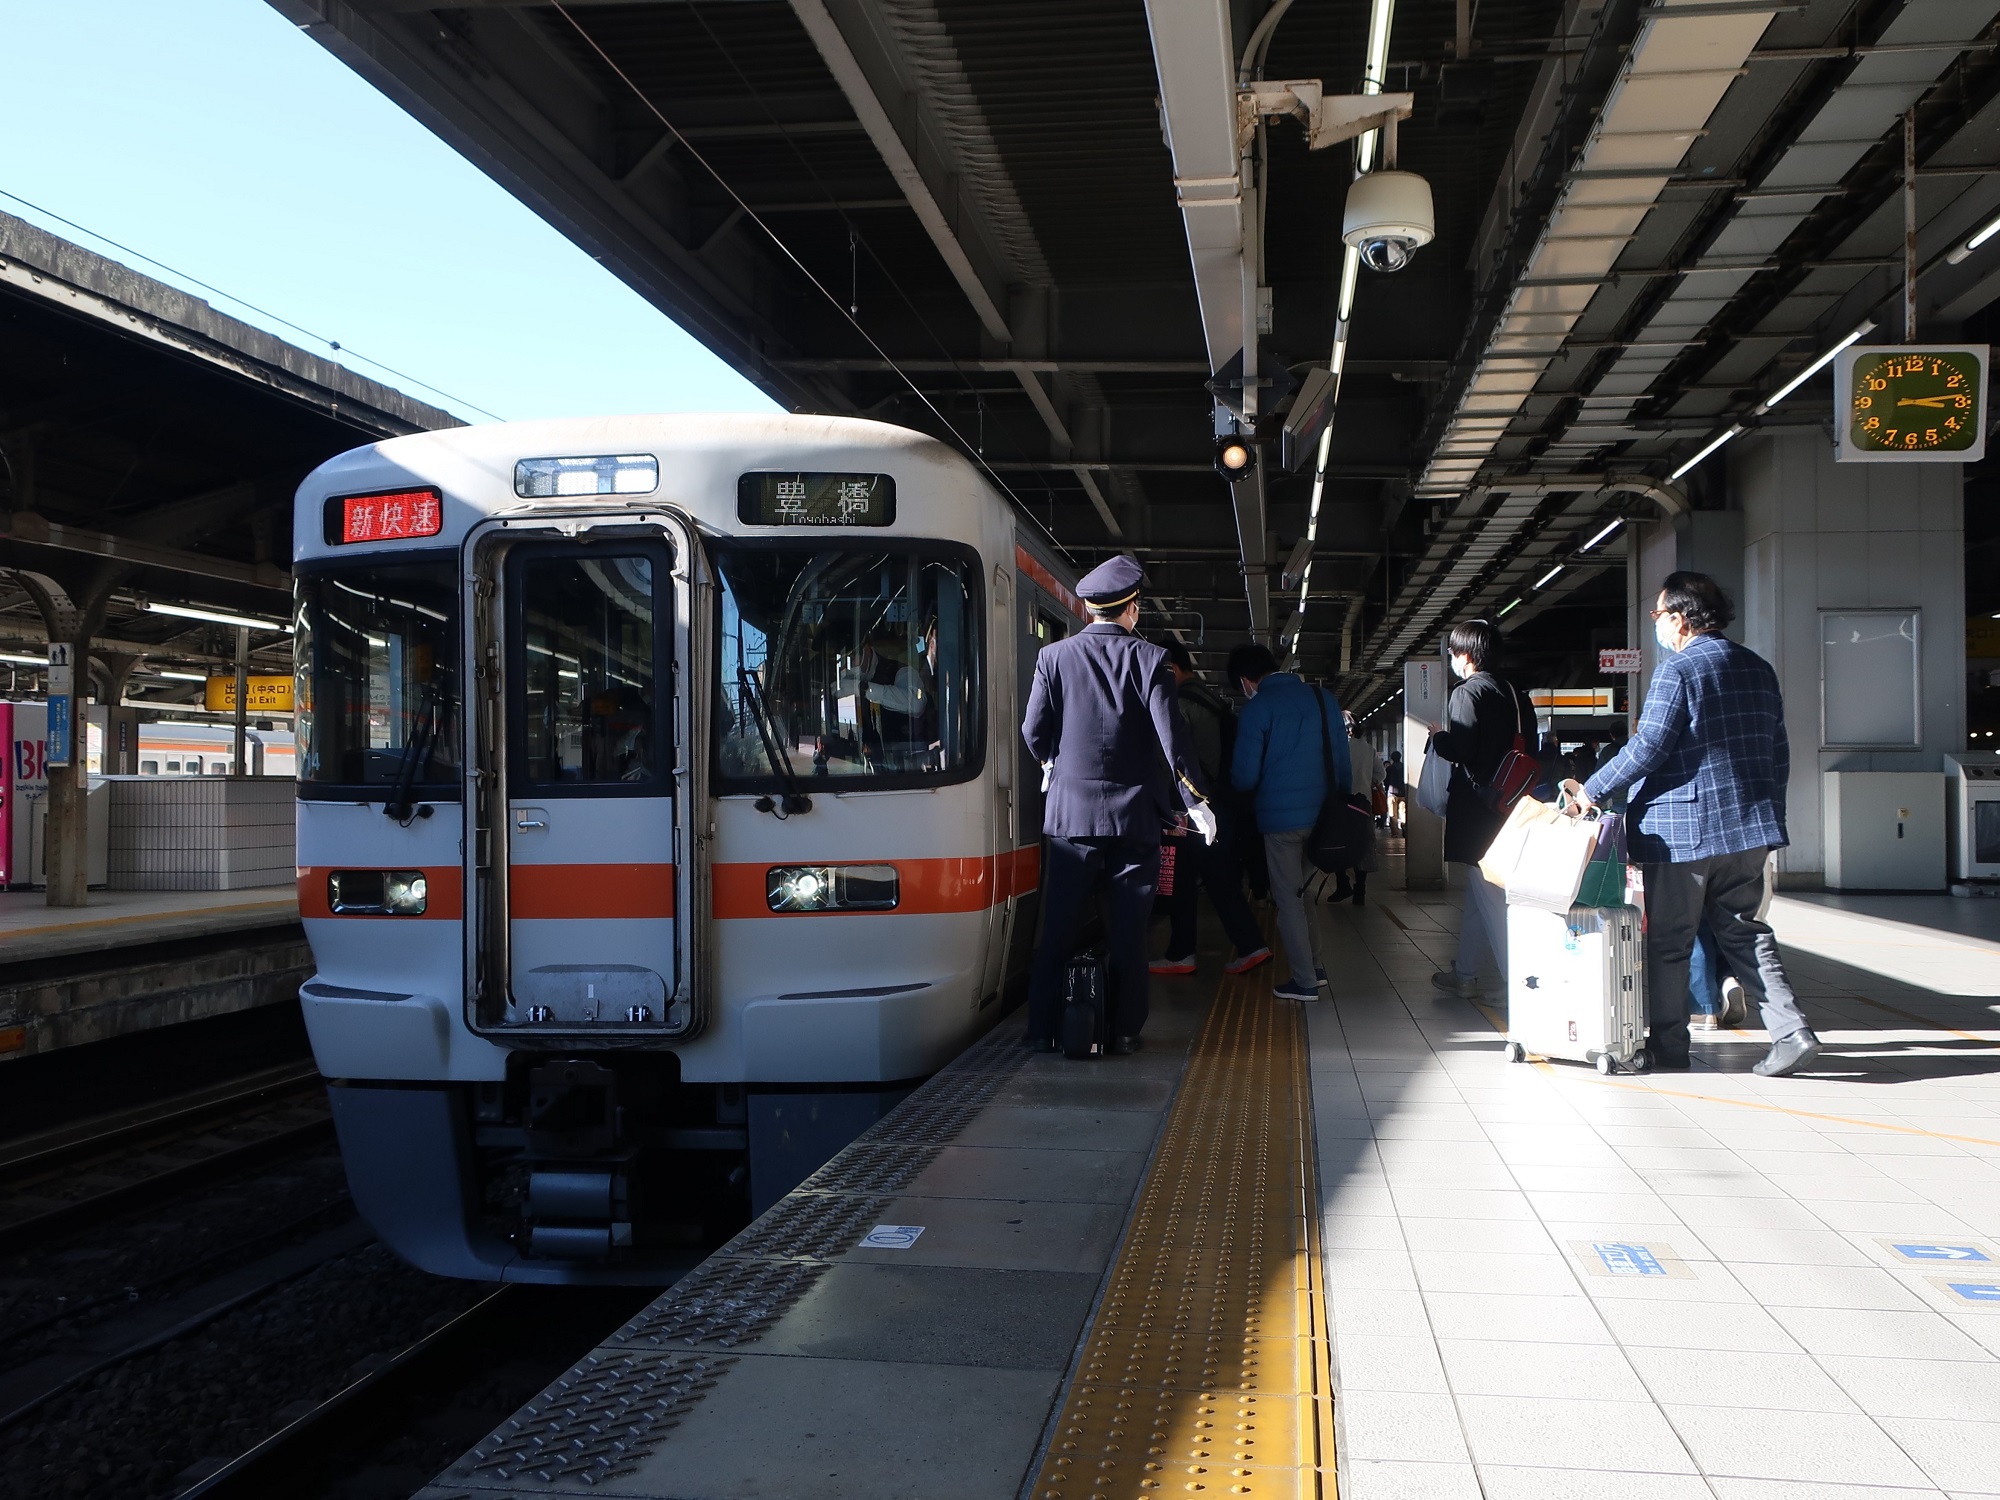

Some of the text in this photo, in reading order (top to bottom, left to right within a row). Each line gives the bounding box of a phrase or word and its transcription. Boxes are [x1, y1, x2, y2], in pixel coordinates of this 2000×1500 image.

[1905, 360, 1923, 371] 12
[1932, 364, 1939, 375] 1
[1887, 366, 1903, 377] 11
[1869, 378, 1887, 390] 10
[1946, 376, 1959, 387] 2
[1860, 397, 1872, 408] 9
[1954, 397, 1966, 408] 3
[1867, 417, 1880, 428] 8
[1944, 417, 1957, 428] 4
[1886, 429, 1898, 441] 7
[1905, 433, 1918, 445] 6
[1925, 429, 1937, 441] 5
[350, 499, 438, 538] 新快速
[225, 683, 291, 695] 出（中央口）
[225, 696, 276, 704] Ceral Exit
